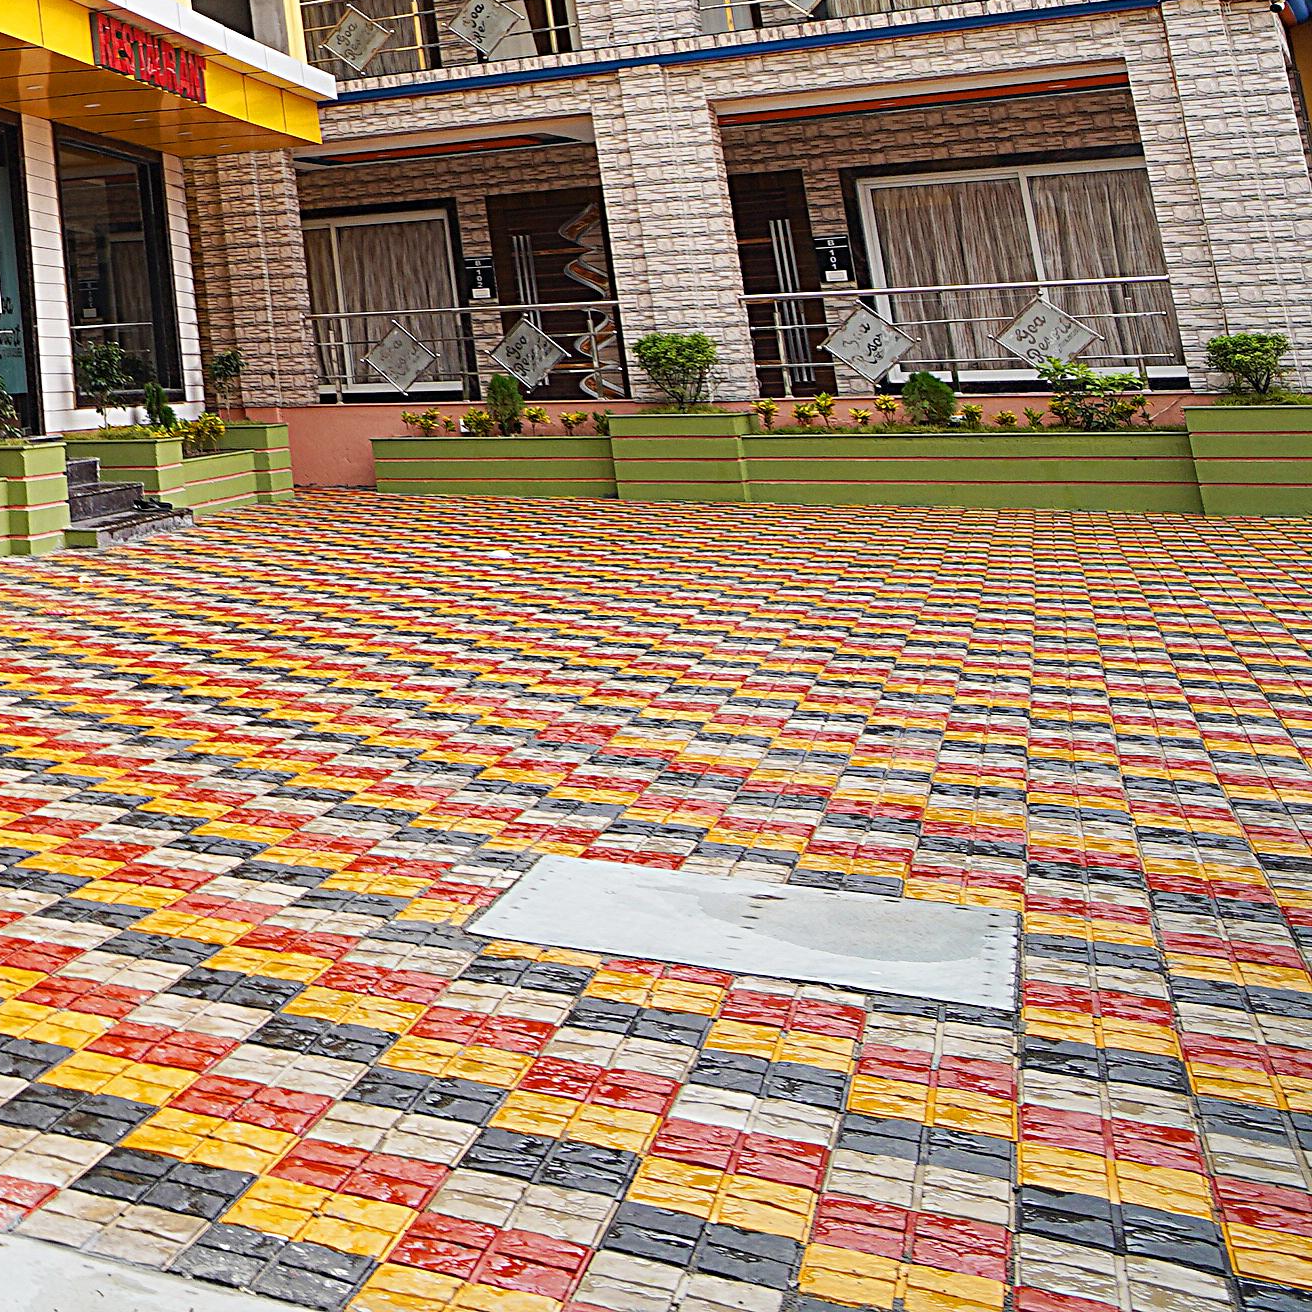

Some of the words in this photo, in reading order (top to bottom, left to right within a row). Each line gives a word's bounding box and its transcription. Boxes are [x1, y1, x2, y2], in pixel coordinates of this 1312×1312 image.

[89, 12, 207, 104] RESTAURANT
[828, 249, 838, 270] 101
[475, 269, 484, 288] 102
